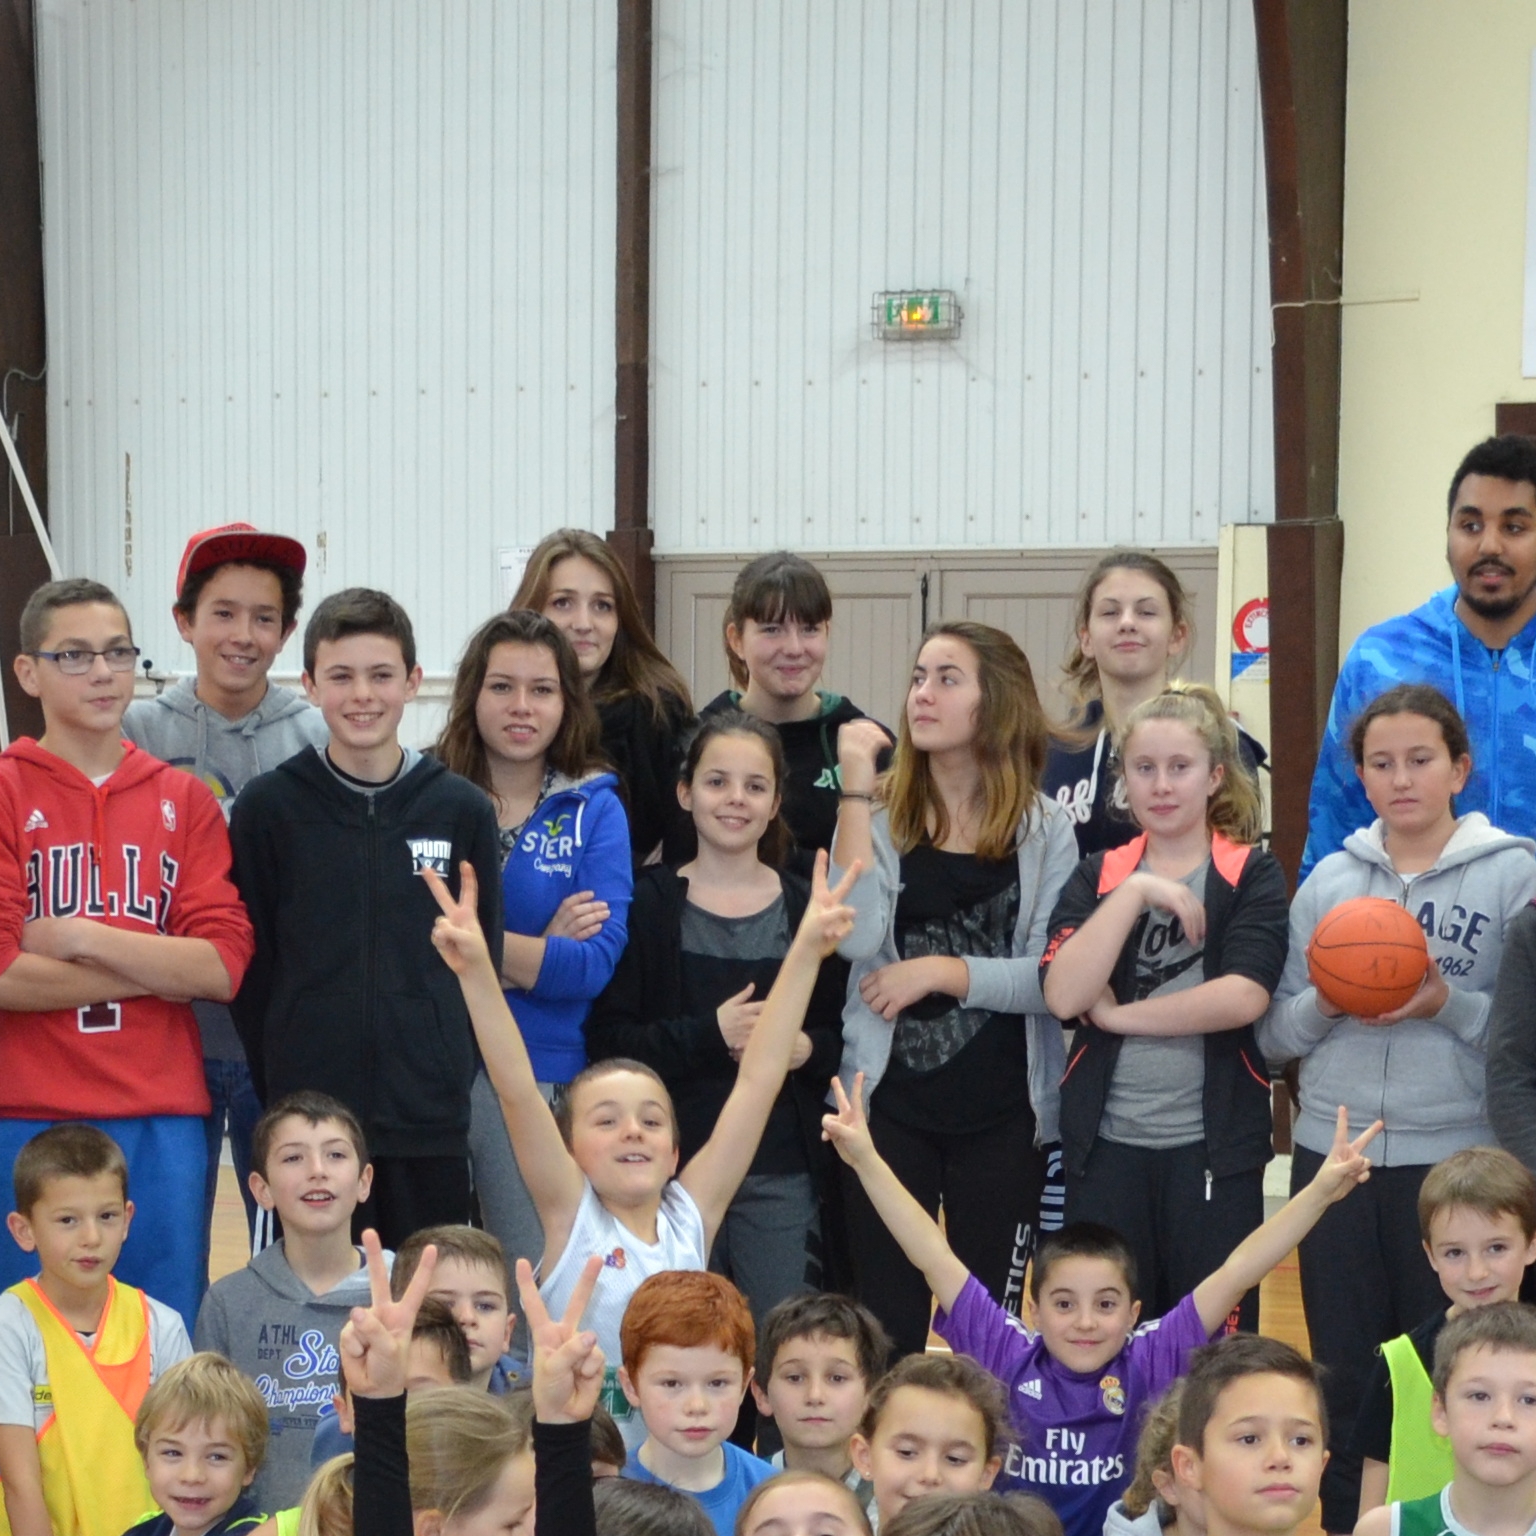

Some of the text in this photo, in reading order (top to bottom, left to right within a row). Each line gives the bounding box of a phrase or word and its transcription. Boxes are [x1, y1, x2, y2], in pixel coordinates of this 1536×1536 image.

[258, 1324, 300, 1346] ATHL
[1045, 1428, 1086, 1455] Fly
[1004, 1442, 1125, 1486] Emirates
